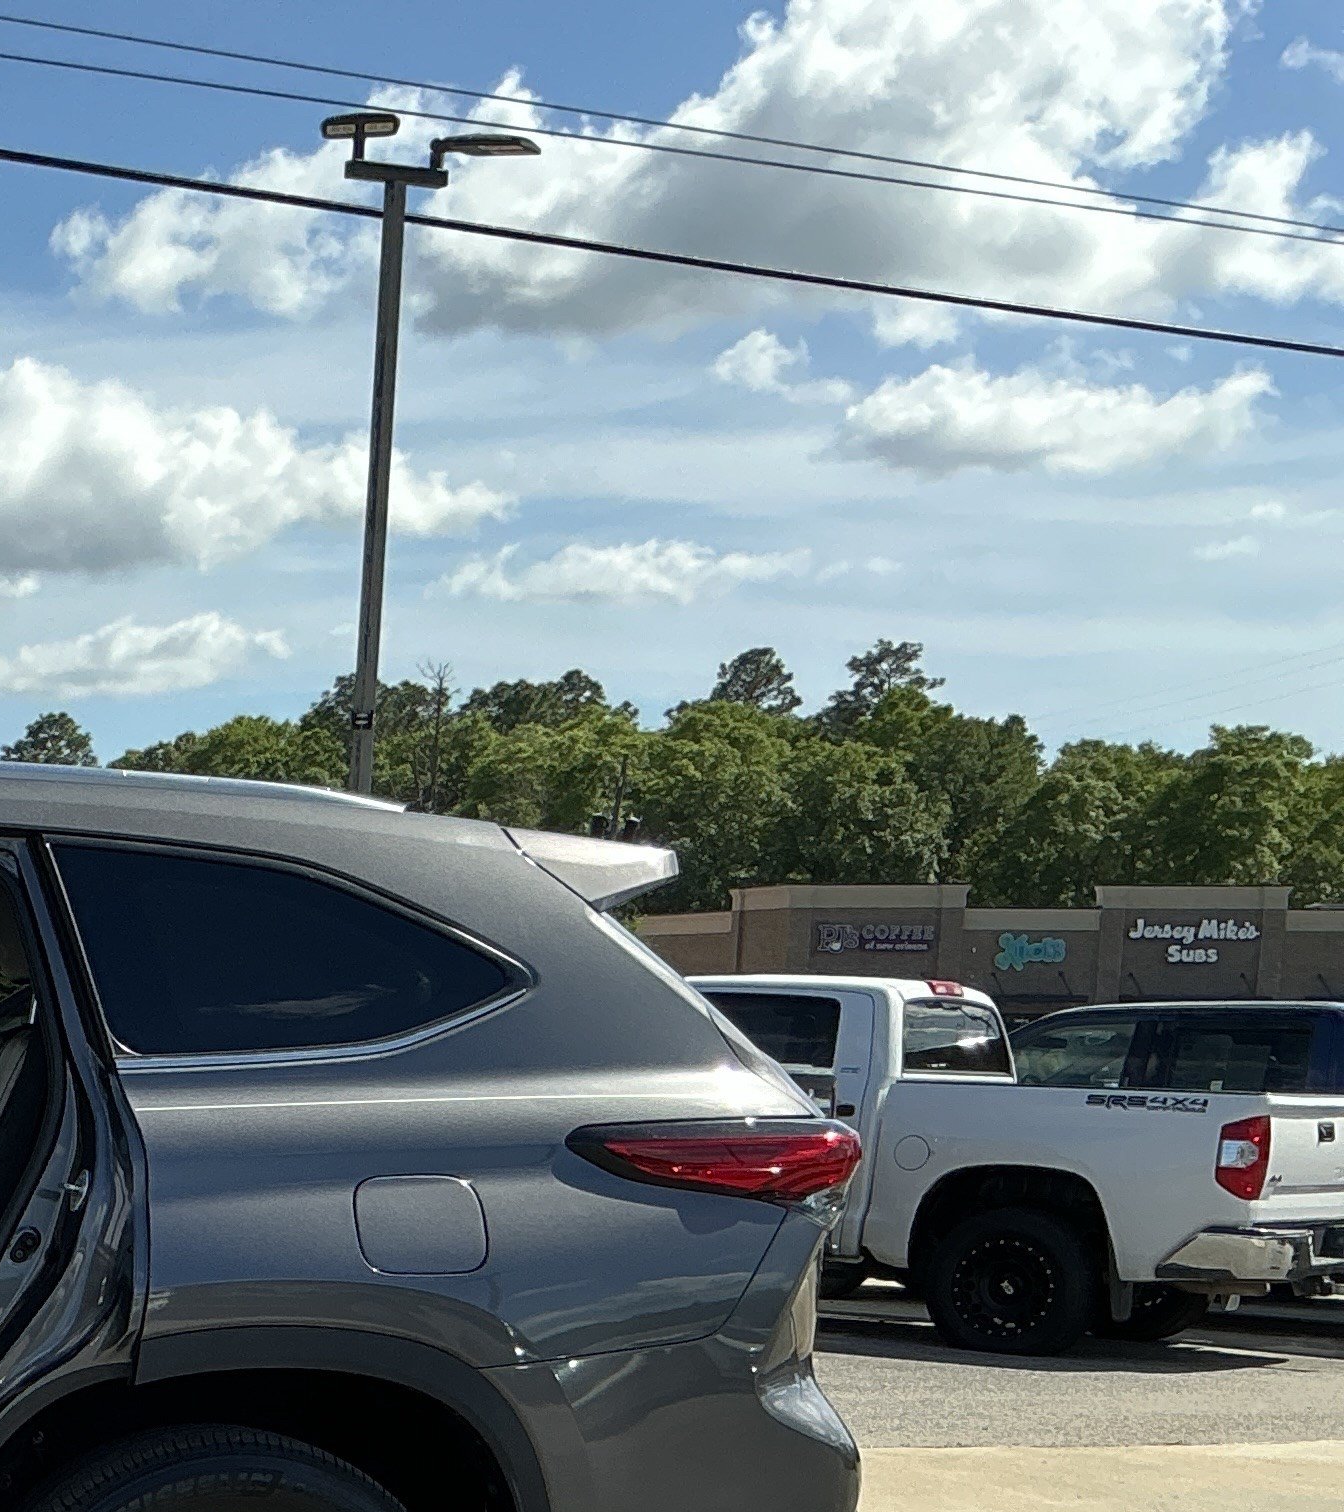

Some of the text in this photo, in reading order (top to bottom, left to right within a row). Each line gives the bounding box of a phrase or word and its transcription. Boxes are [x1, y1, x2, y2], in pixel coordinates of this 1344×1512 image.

[861, 924, 934, 941] COFFEE
[1129, 918, 1261, 944] Jersey Mike's
